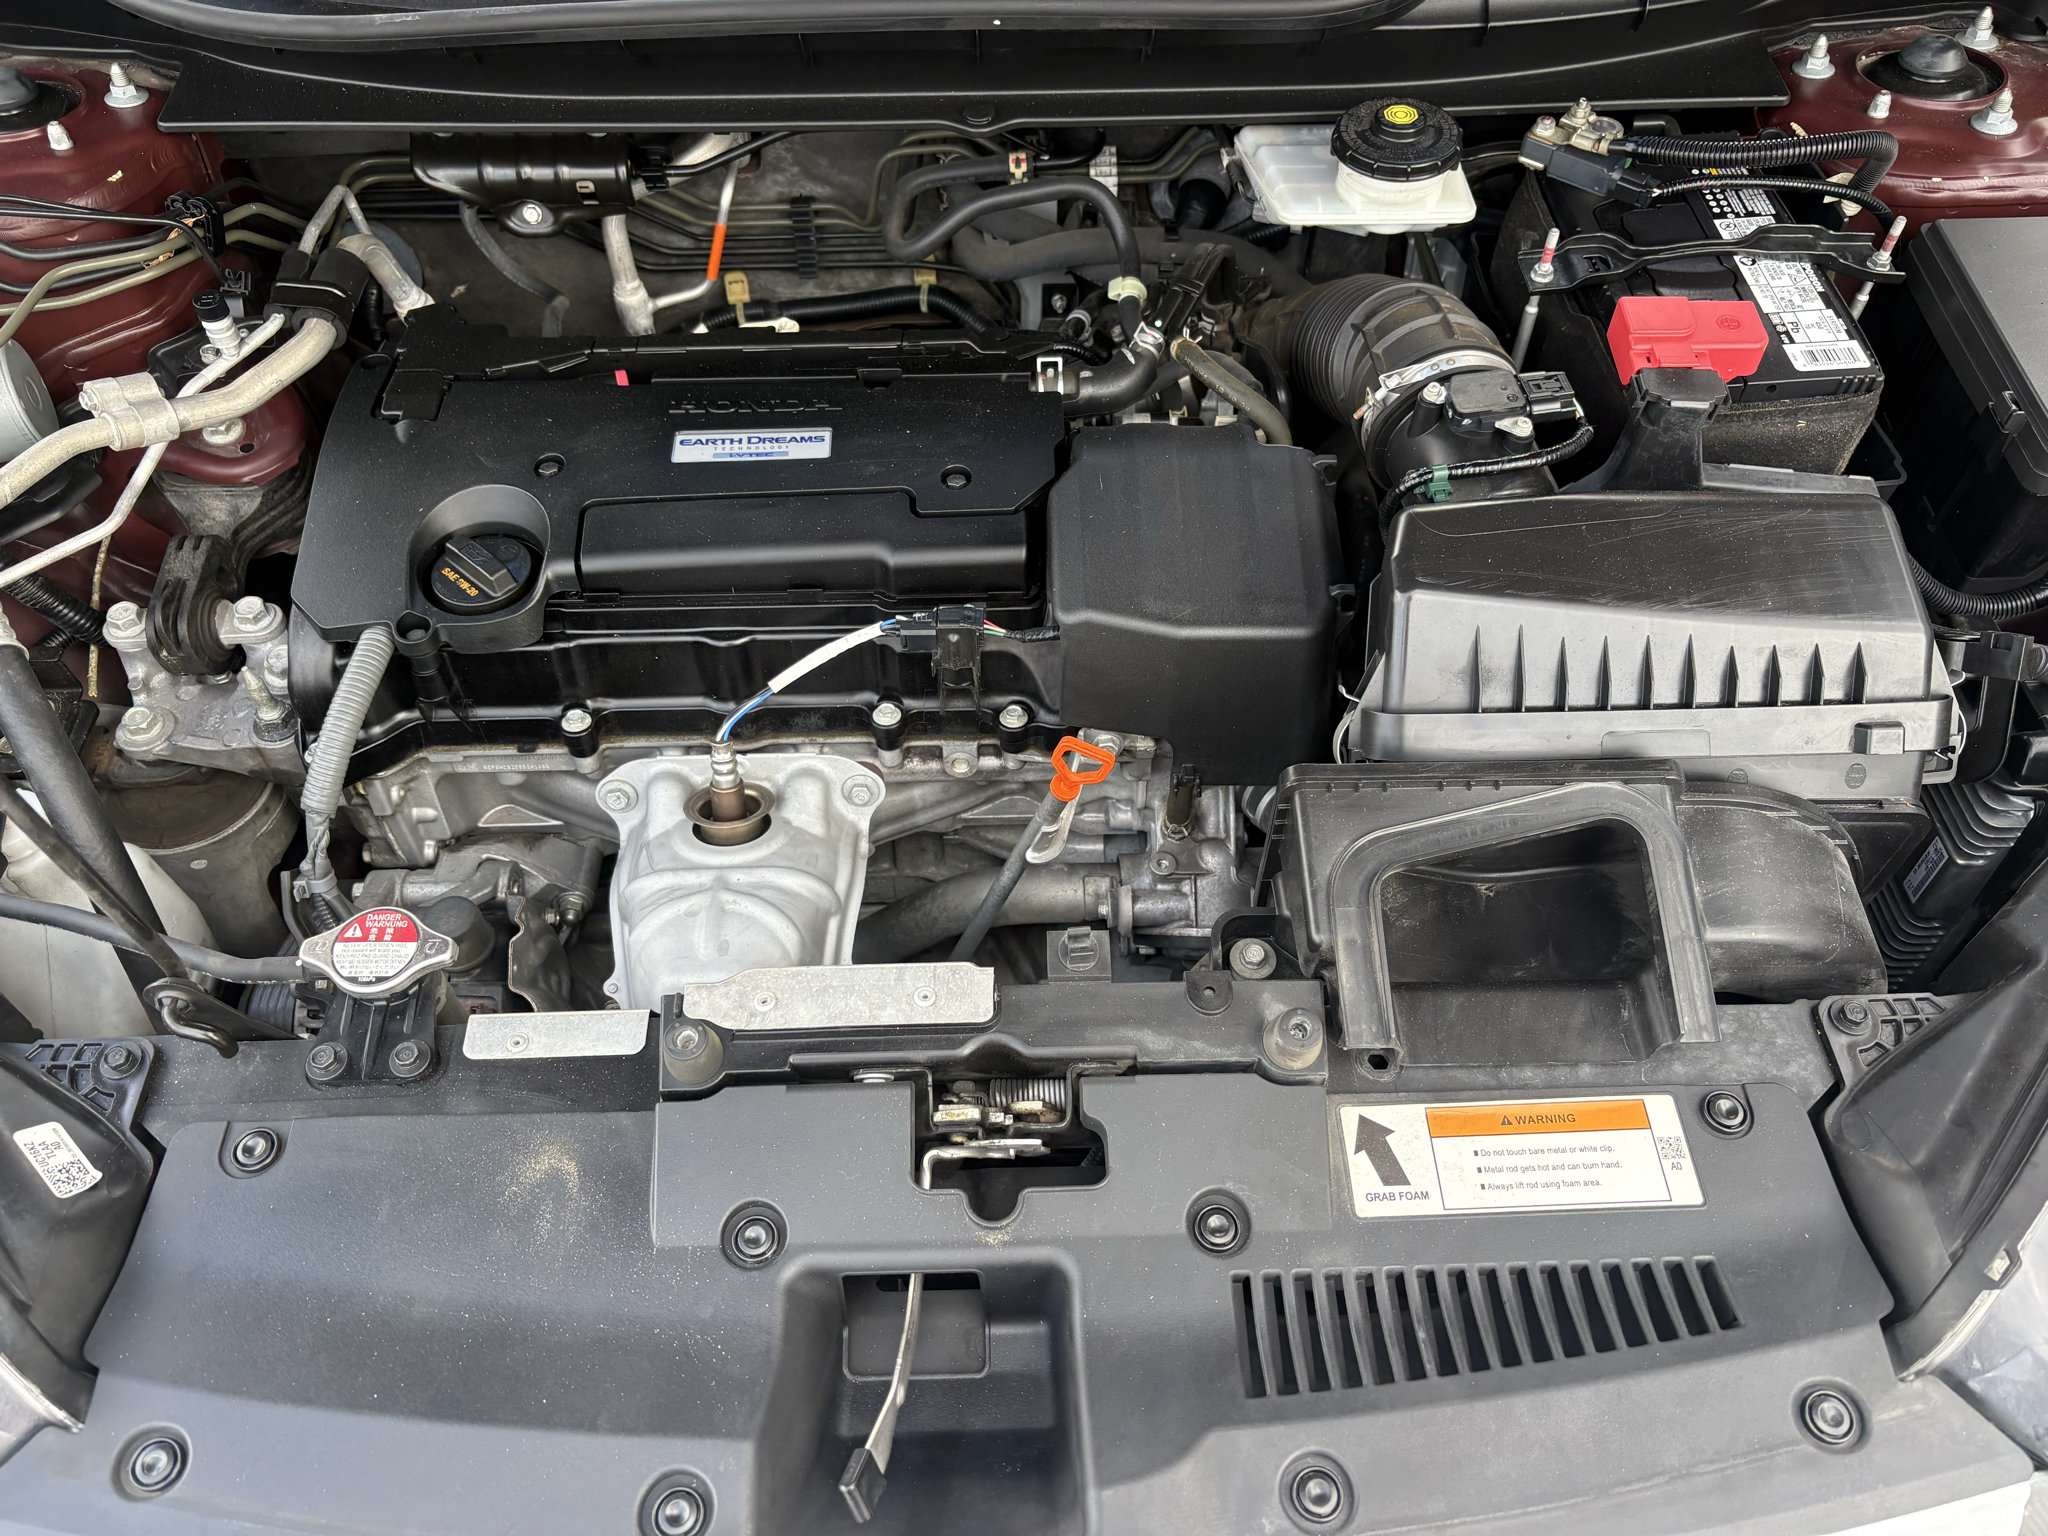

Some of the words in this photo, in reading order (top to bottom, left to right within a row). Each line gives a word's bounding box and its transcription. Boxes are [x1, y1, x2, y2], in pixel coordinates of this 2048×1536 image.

[1800, 262, 1825, 292] POISON
[1787, 321, 1801, 333] Pb
[668, 399, 844, 413] HONDA
[679, 438, 743, 447] EARTH
[747, 435, 826, 445] DREAMS
[441, 567, 460, 582] SAE
[366, 913, 401, 921] DANGER
[365, 920, 408, 928] WARNUNG
[1514, 1113, 1576, 1125] WARNING
[38, 1140, 57, 1159] TLAA
[1506, 1148, 1527, 1156] touch
[1528, 1147, 1545, 1155] bare
[1547, 1146, 1567, 1154] metal
[1578, 1145, 1598, 1153] white
[1600, 1144, 1615, 1154] clip.
[1484, 1165, 1505, 1173] Metal
[1506, 1165, 1518, 1173] rod
[1519, 1164, 1536, 1173] gets
[1538, 1163, 1550, 1171] hot
[1551, 1163, 1565, 1171] and
[1582, 1161, 1600, 1169] burn
[1601, 1160, 1623, 1169] hand.
[1671, 1162, 1683, 1171] A0
[1487, 1182, 1513, 1191] Always
[1515, 1181, 1525, 1189] lift
[1526, 1181, 1539, 1189] rod
[1540, 1180, 1561, 1190] using
[1562, 1179, 1581, 1187] foam
[1365, 1192, 1396, 1202] GRAB
[1399, 1191, 1430, 1201] FOAM
